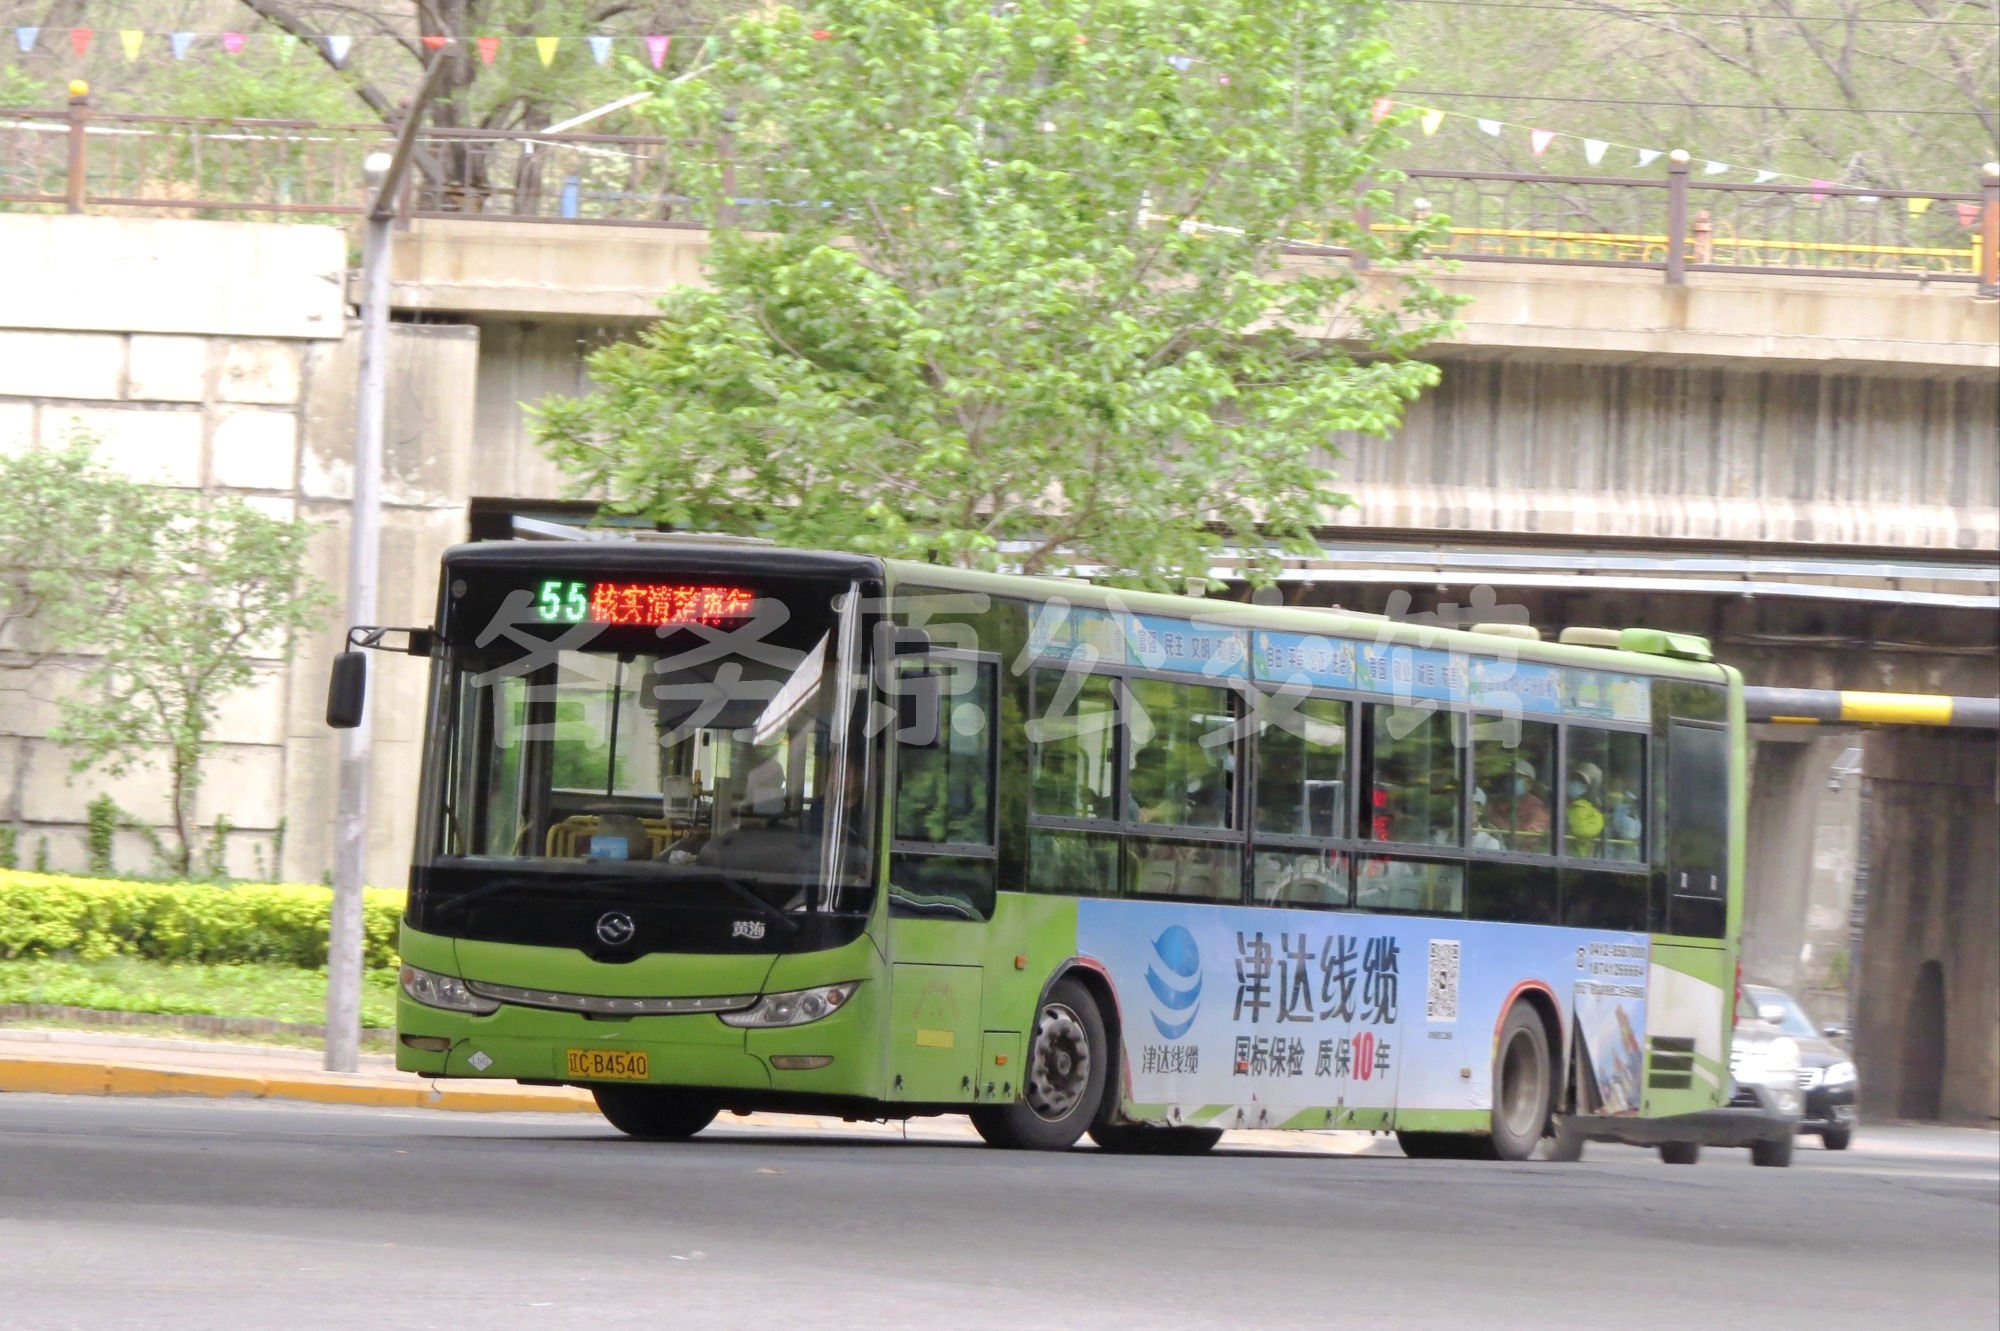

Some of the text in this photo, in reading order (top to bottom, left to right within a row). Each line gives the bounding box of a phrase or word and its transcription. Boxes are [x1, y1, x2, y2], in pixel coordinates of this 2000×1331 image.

[539, 581, 588, 621] 55
[1165, 631, 1185, 657] 民主
[1191, 636, 1211, 660] 文明
[732, 920, 766, 939] 黄海
[1233, 931, 1400, 1025] 津达线缆
[472, 1056, 489, 1065] LNG
[1141, 1045, 1200, 1075] 津达线缆
[1232, 1031, 1392, 1082] 国标保检 质保10年
